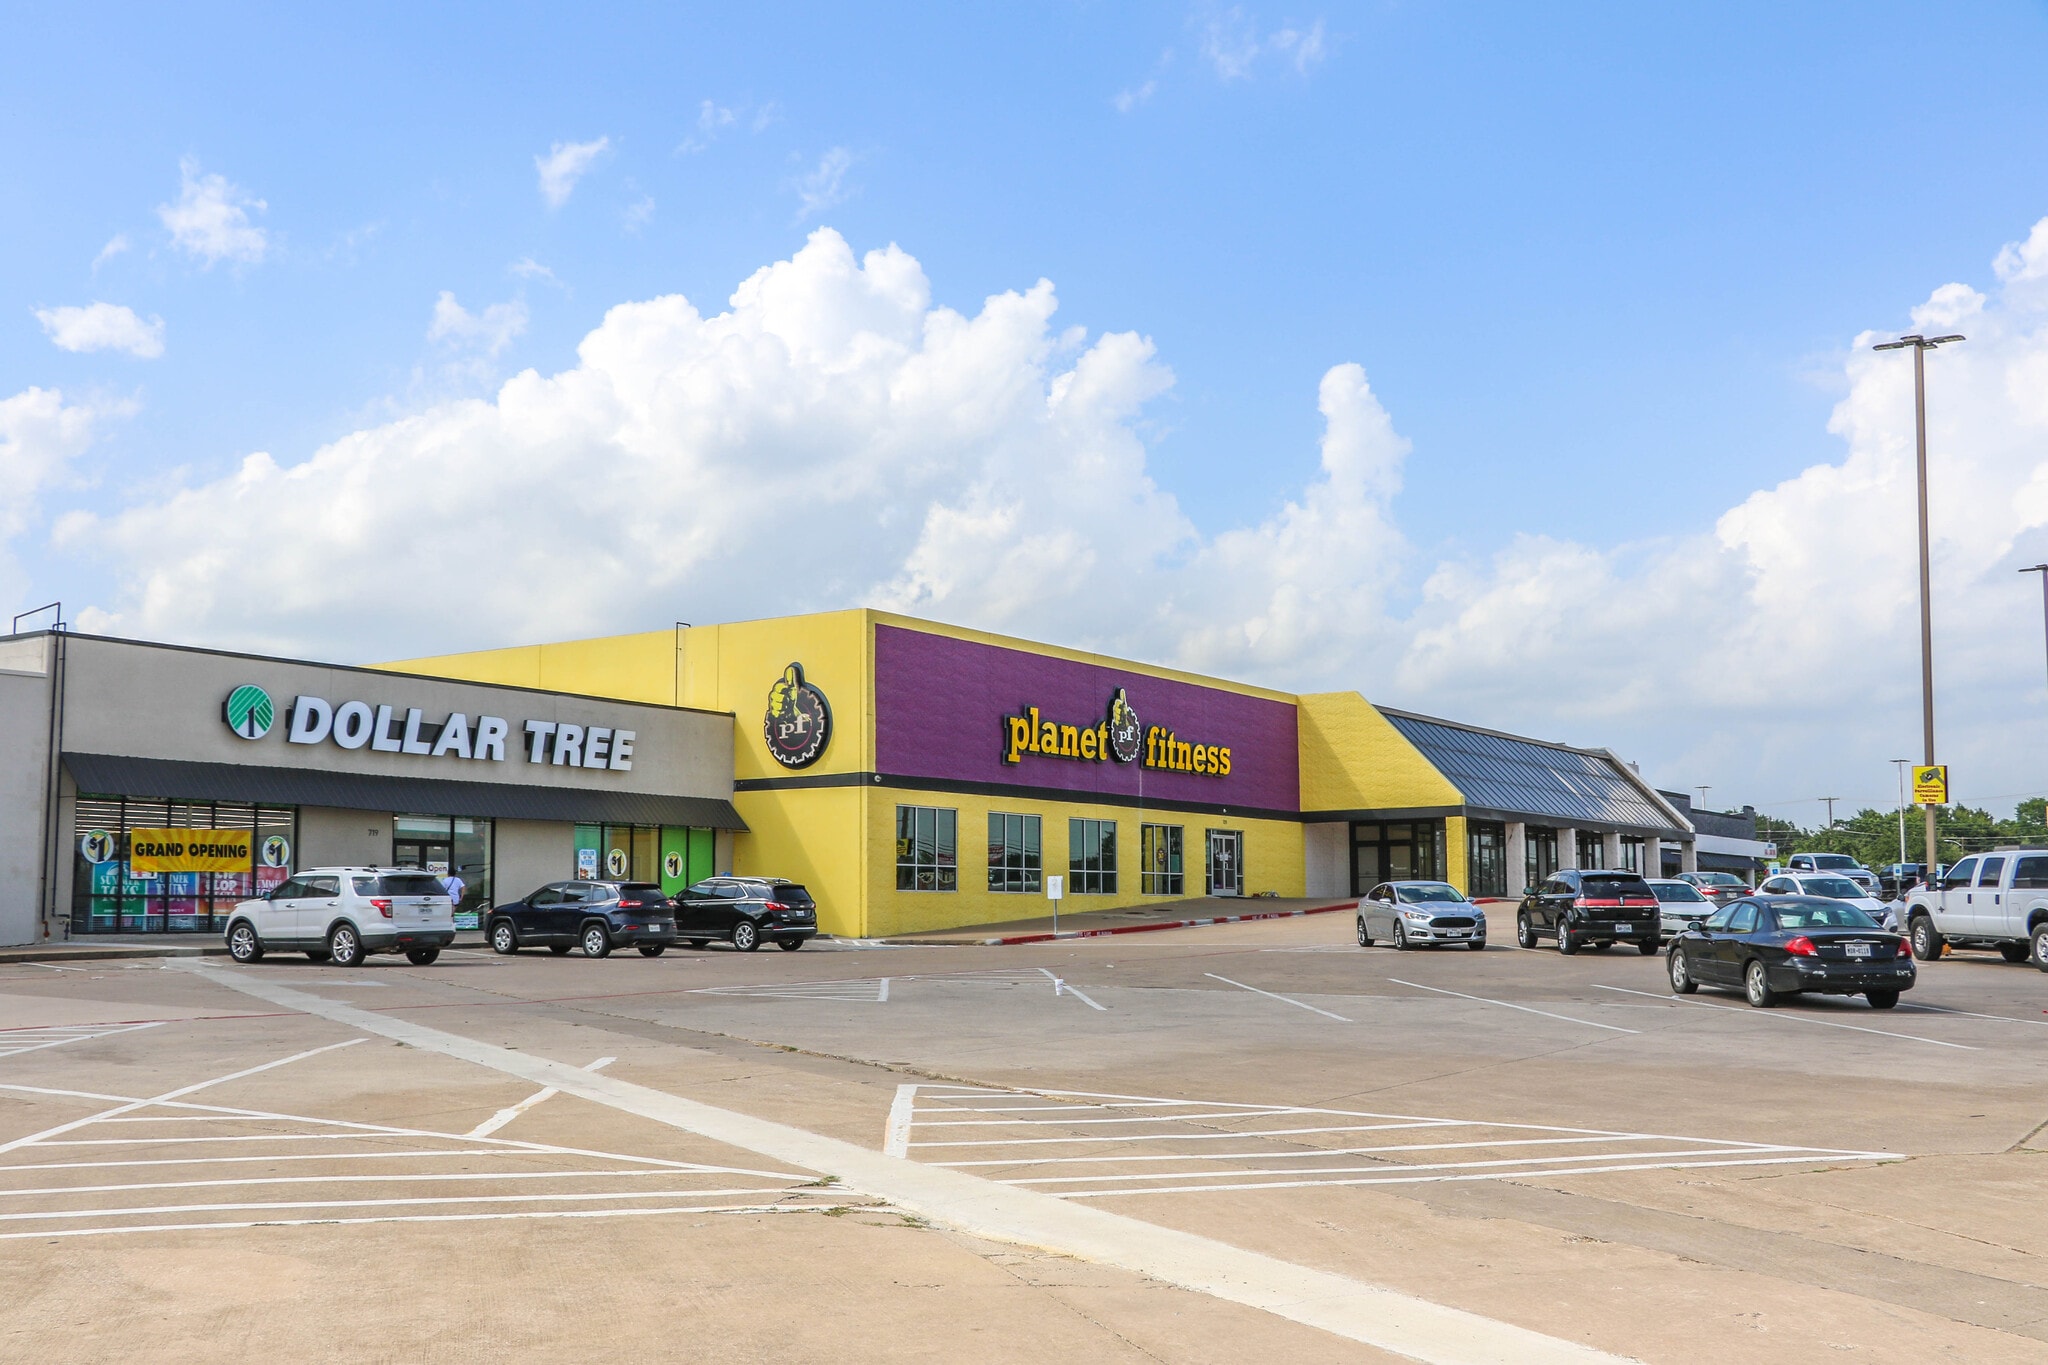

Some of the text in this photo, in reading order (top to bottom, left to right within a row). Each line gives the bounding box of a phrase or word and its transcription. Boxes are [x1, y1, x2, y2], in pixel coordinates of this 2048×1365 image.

[288, 695, 637, 771] DOLLAR TREE
[779, 713, 811, 739] pf
[1008, 707, 1108, 763] planet
[1118, 726, 1135, 742] pf
[1146, 725, 1231, 775] fitness
[367, 828, 379, 837] 719
[135, 843, 247, 858] GRAND OPENING
[428, 864, 447, 874] Open
